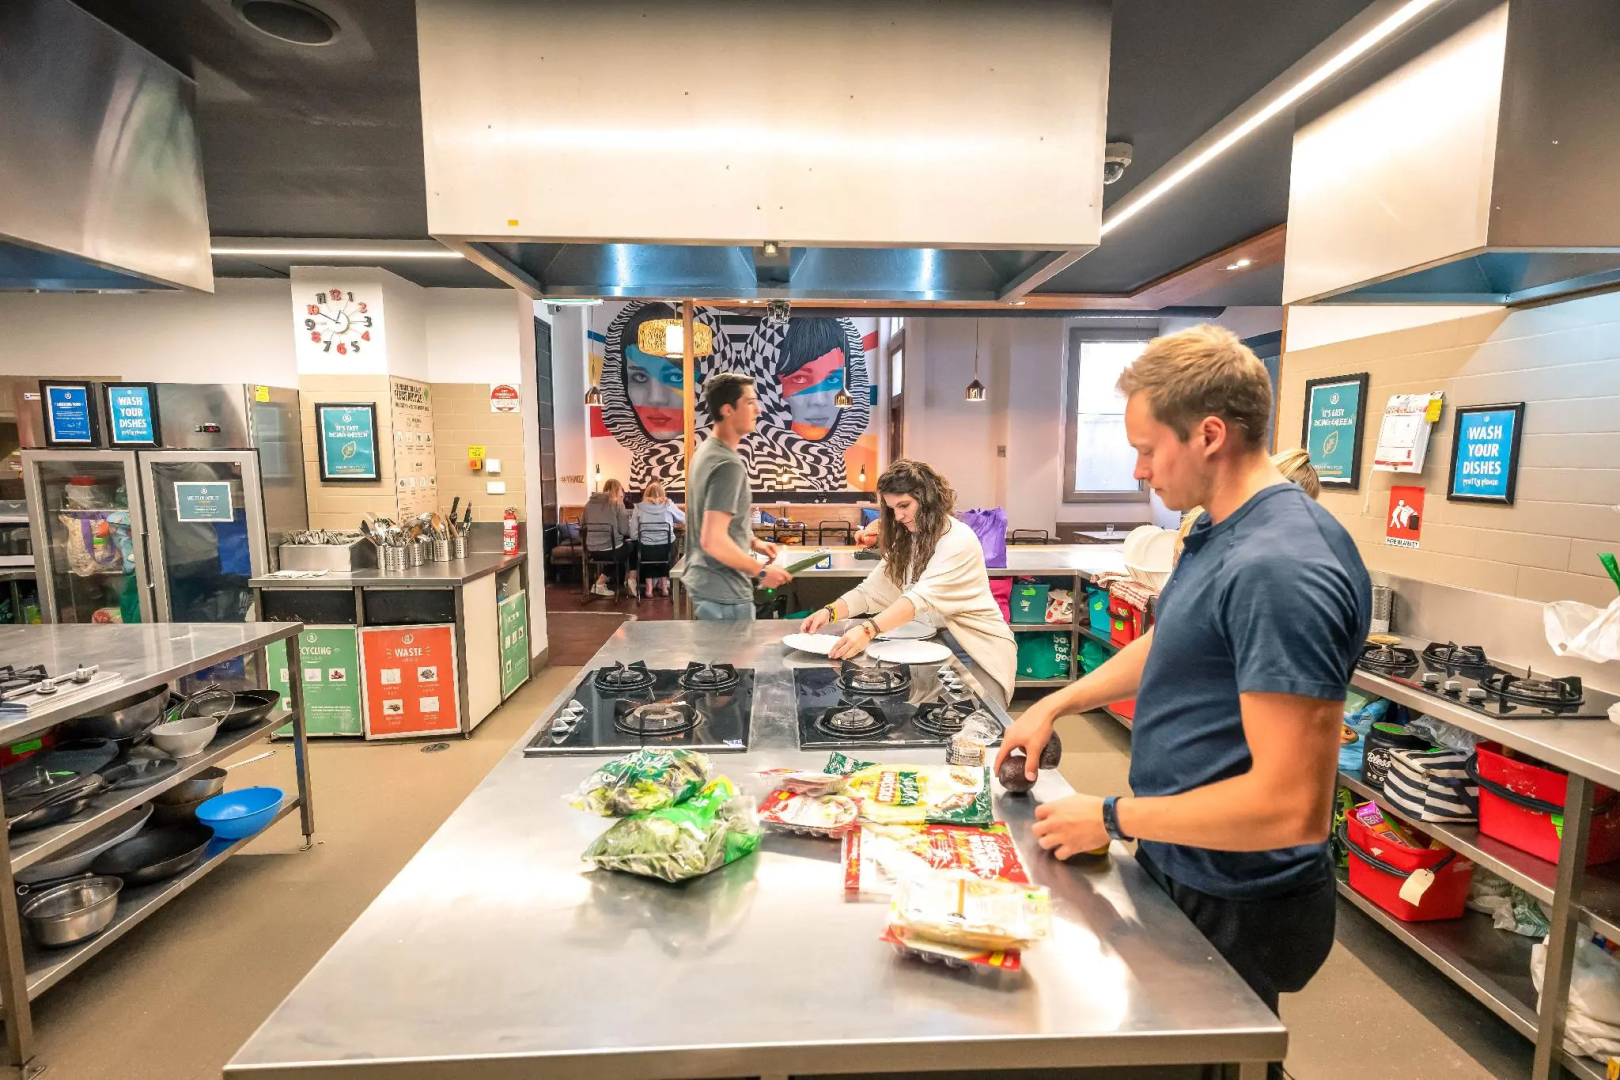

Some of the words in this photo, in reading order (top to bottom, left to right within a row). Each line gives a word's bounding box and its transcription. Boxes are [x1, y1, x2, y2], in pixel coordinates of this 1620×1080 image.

[329, 288, 342, 301] 12
[347, 292, 354, 302] 1
[358, 301, 368, 313] 2
[305, 319, 316, 330] 9
[364, 316, 372, 327] 3
[311, 331, 321, 343] 8
[323, 341, 331, 352] 7
[337, 343, 347, 354] 6
[351, 341, 360, 352] 5
[118, 396, 143, 406] WASH
[120, 407, 144, 417] YOUR
[119, 418, 147, 428] DISHES
[1331, 418, 1352, 426] GREEN
[1468, 425, 1503, 440] WASH
[1468, 443, 1500, 457] YOUR
[1462, 460, 1502, 475] DISHES
[301, 647, 332, 655] CYCLING
[395, 647, 423, 657] WASTE
[1054, 643, 1068, 653] for
